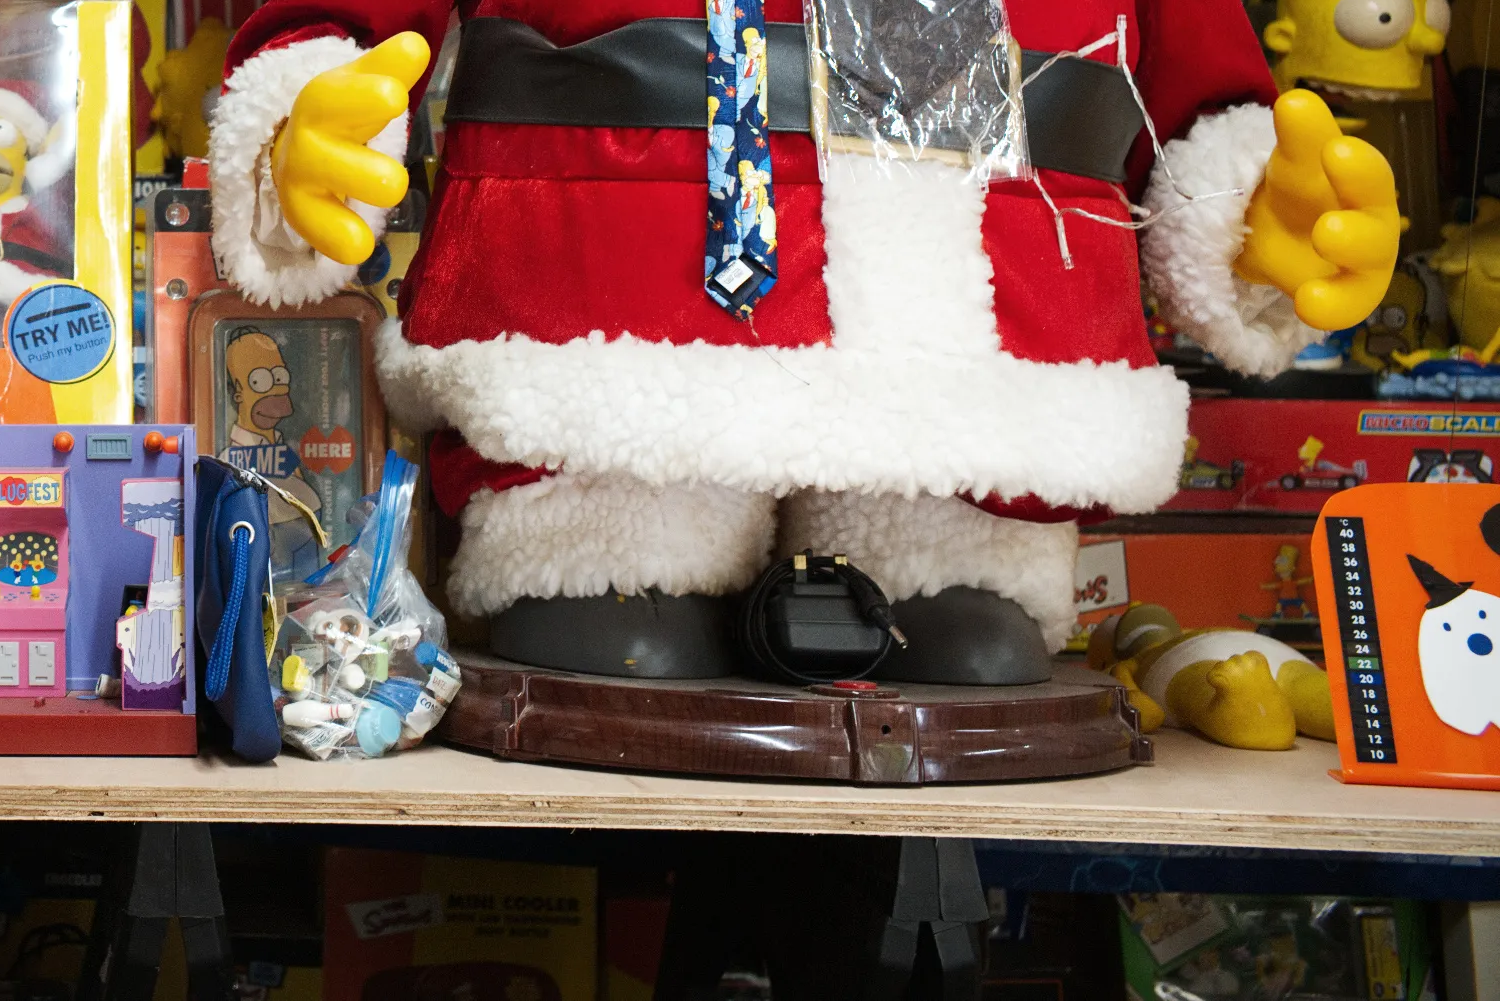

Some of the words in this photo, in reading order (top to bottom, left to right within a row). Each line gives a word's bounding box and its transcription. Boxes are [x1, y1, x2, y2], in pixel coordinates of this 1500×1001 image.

[15, 323, 60, 351] TRY
[66, 311, 111, 339] ME!
[27, 350, 55, 363] Push
[56, 346, 73, 357] my
[73, 335, 108, 352] button
[304, 442, 352, 458] HERE
[229, 449, 251, 472] TRY
[257, 444, 288, 476] ME
[1339, 518, 1349, 527] °C
[1339, 529, 1354, 538] 40
[1341, 543, 1356, 553] 38
[1343, 558, 1358, 567] 36
[1345, 572, 1360, 581] 34
[1347, 586, 1362, 595] 32
[1350, 601, 1364, 610] 30
[1351, 616, 1366, 625] 28
[1353, 630, 1368, 639] 26
[1355, 645, 1370, 654] 24
[1357, 660, 1372, 669] 22
[432, 675, 446, 690] DATE
[1359, 674, 1374, 684] 20
[1362, 690, 1376, 699] 18
[1364, 705, 1378, 714] 16
[1366, 720, 1380, 729] 14
[1368, 735, 1382, 744] 12
[1370, 750, 1384, 760] 10
[503, 895, 581, 911] COOLER
